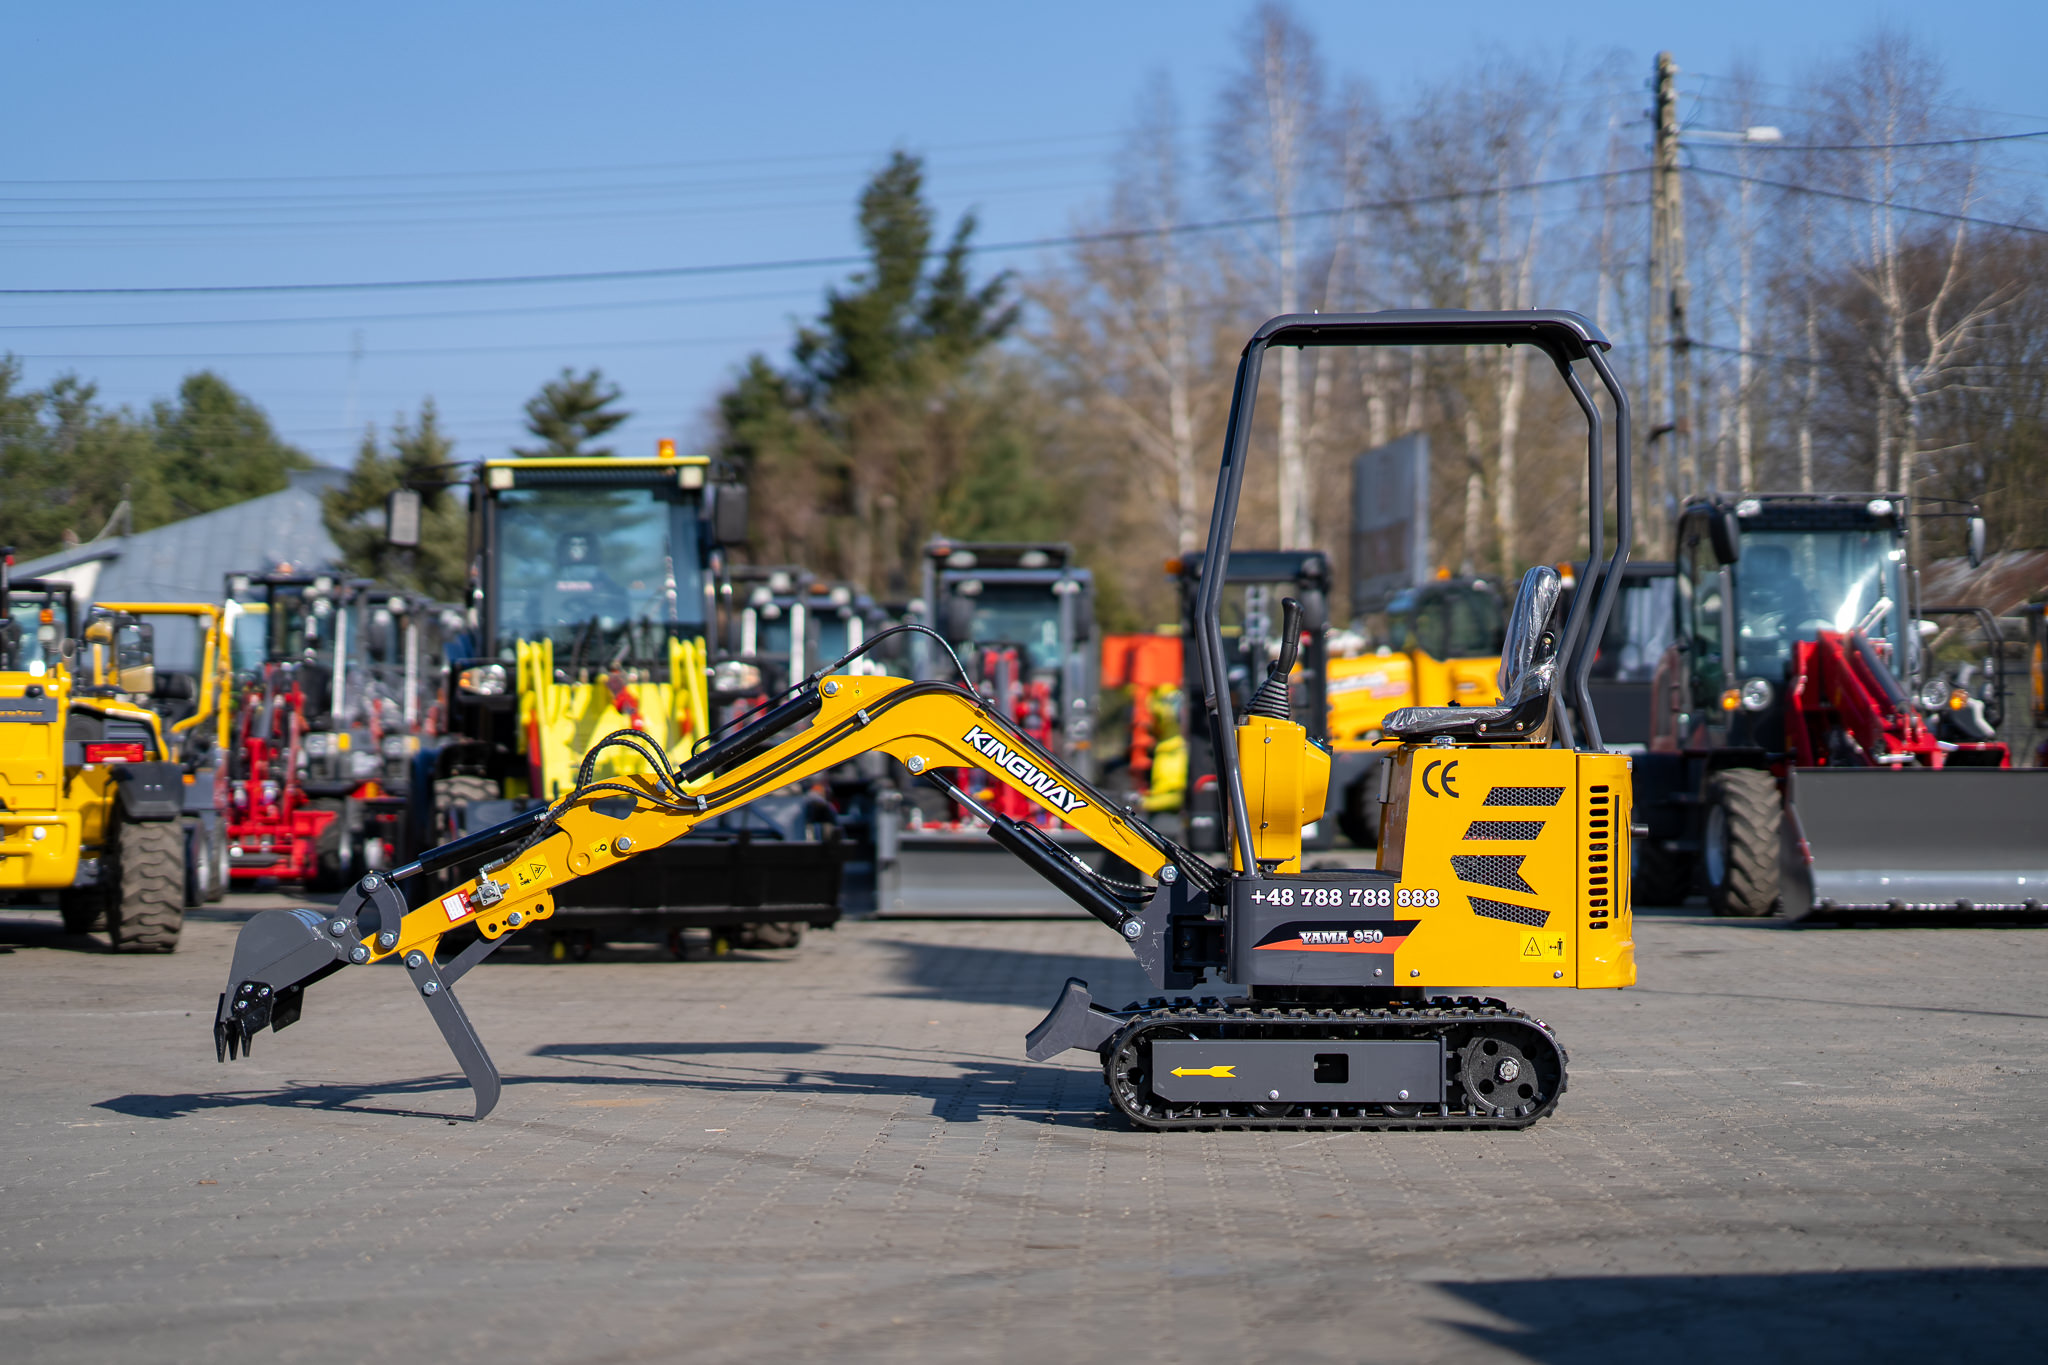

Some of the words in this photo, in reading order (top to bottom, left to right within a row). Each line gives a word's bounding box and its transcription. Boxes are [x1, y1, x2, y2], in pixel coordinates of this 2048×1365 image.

[961, 725, 1089, 814] KINGWAY
[1422, 760, 1459, 798] CE
[1250, 888, 1295, 906] +48
[1300, 888, 1343, 907] 788
[1349, 888, 1391, 907] 788
[1397, 889, 1440, 907] 888
[1299, 931, 1349, 945] YAMA
[1353, 930, 1384, 943] 950
